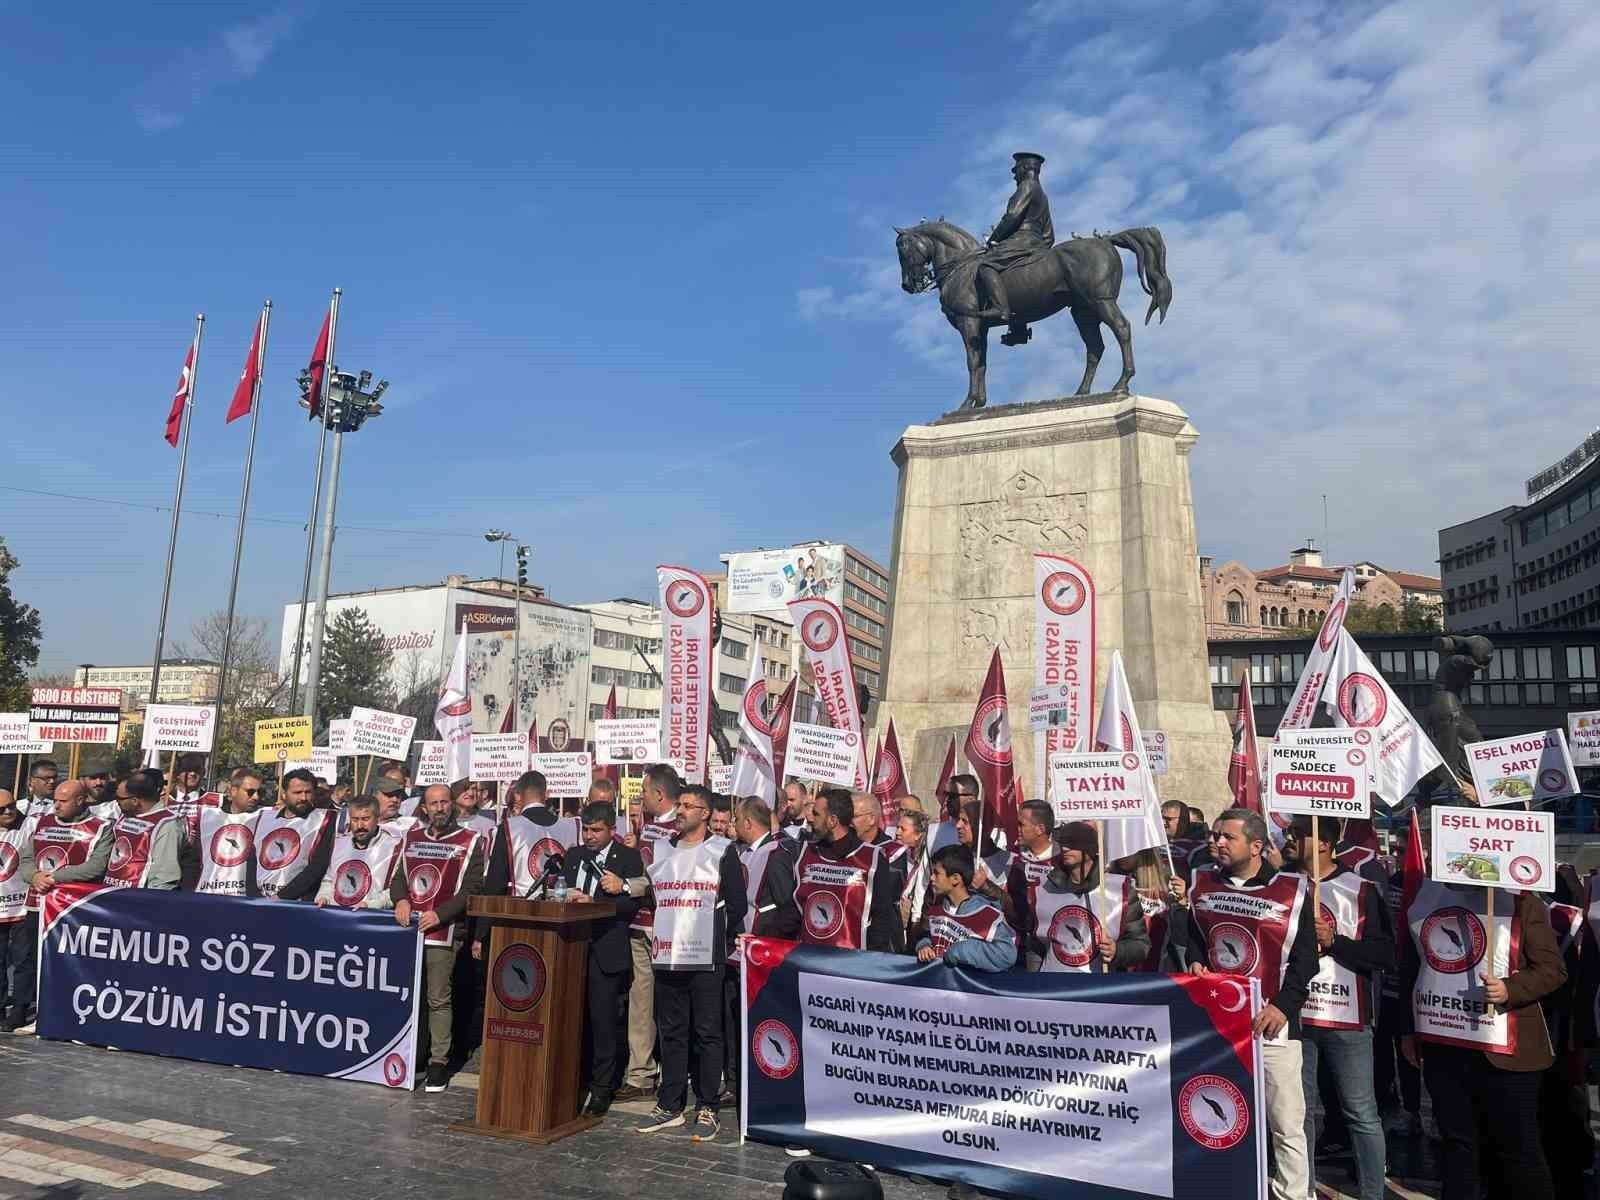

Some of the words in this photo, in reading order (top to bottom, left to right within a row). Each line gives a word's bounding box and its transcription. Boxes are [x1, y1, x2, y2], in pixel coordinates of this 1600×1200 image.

[32, 688, 59, 704] 3600
[60, 689, 74, 704] EK
[74, 688, 120, 704] GÖSTERGE
[30, 706, 48, 720] TÜM
[48, 708, 72, 720] KAMU
[153, 716, 206, 726] GELİŞTİRME
[372, 714, 394, 724] 3600
[40, 724, 108, 740] VERİLSİN!!!
[158, 727, 198, 736] ÖDENEĞİ
[258, 722, 284, 730] HÜLLE
[286, 720, 309, 728] DEĞİL
[365, 722, 408, 736] GÖSTERGE
[154, 739, 200, 748] HAKKIMIZ
[352, 736, 376, 744] KADAR
[378, 740, 400, 750] KARAR
[372, 732, 391, 740] DAHA
[1297, 736, 1353, 745] ÜNİVERSİTE
[262, 740, 304, 750] İSTİYORUZ
[1474, 746, 1508, 761] EŞEL
[1510, 736, 1560, 754] MOBİL
[1274, 749, 1316, 759] MEMUR
[1290, 762, 1336, 772] SADECE
[1502, 758, 1538, 774] ŞART
[1066, 772, 1124, 792] TAYİN
[1282, 778, 1348, 794] HAKKINI
[1060, 796, 1109, 810] SİSTEMİ
[1112, 798, 1142, 811] ŞART
[1310, 796, 1362, 812] İSTİYOR
[1441, 814, 1480, 830] EŞEL
[1486, 816, 1544, 833] MOBİL
[1469, 838, 1516, 852] ŞART
[1208, 895, 1254, 906] HAKLARIMIZ
[1254, 901, 1273, 912] İÇİN
[57, 923, 190, 968] MEMUR
[200, 933, 276, 978] SÖZ
[286, 945, 410, 1003] DEĞİL,
[72, 980, 203, 1032] ÇÖZÜM
[215, 992, 370, 1054] İSTİYOR
[808, 994, 855, 1012] ASGARİ
[857, 1001, 906, 1020] YAŞAM
[909, 1008, 1011, 1032] KOŞULLARINI
[1014, 1020, 1158, 1042] OLUŞTURMAKTA
[809, 1016, 874, 1038] ZORLANIP
[876, 1027, 926, 1047] YAŞAM
[930, 1030, 952, 1049] İLE
[954, 1034, 1000, 1055] ÖLÜM
[1004, 1042, 1090, 1061] ARASINDA
[1092, 1050, 1158, 1070] ARAFTA
[831, 1042, 876, 1062] KALAN
[878, 1050, 911, 1068] TÜM
[914, 1057, 1052, 1082] MEMURLARIMIZIN
[1056, 1069, 1128, 1094] HAYRINA
[825, 1064, 874, 1084] BUGÜN
[878, 1072, 939, 1093] BURADA
[942, 1081, 998, 1100] LOKMA
[1001, 1085, 1104, 1117] DÖKÜYORUZ.
[1108, 1102, 1140, 1124] HİÇ
[854, 1092, 924, 1113] OLMAZSA
[926, 1101, 988, 1124] MEMURA
[992, 1110, 1016, 1130] BİR
[1020, 1116, 1102, 1142] HAYRIMIZ
[942, 1130, 1000, 1152] OLSUN.
